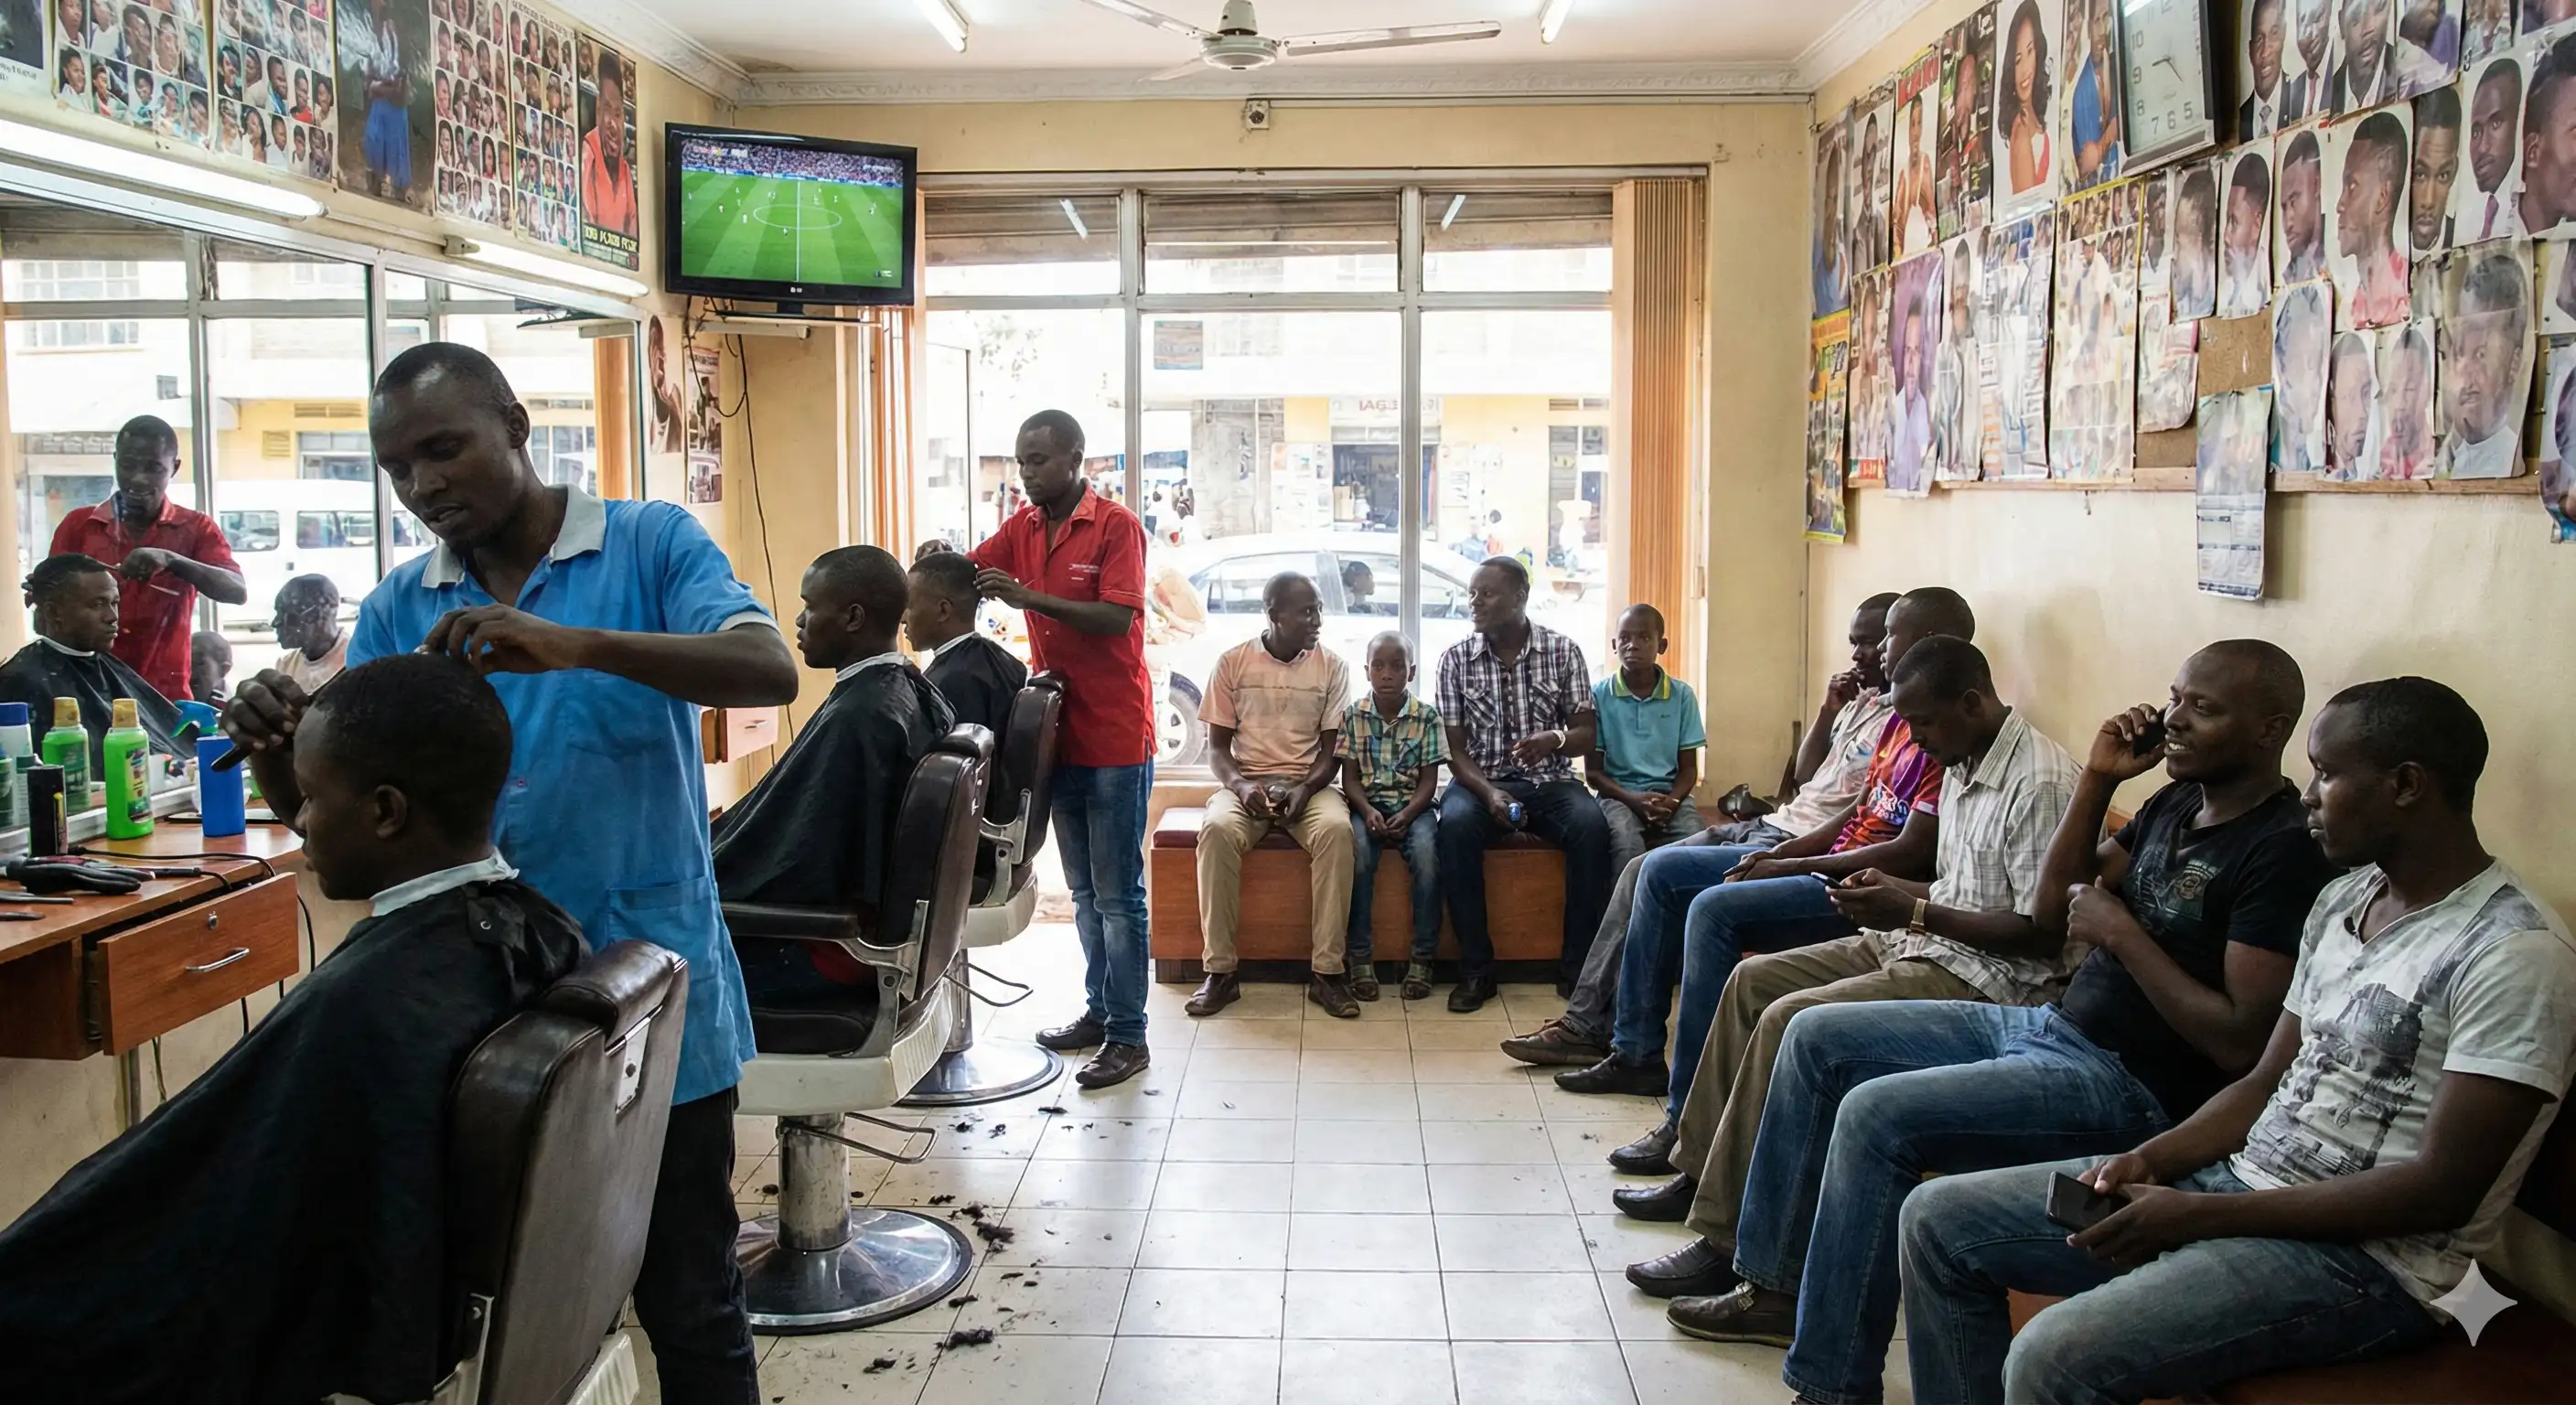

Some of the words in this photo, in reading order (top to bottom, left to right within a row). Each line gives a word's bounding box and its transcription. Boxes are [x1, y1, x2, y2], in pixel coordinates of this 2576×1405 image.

[2131, 29, 2143, 49] 10
[2132, 66, 2141, 84] 9
[2136, 99, 2145, 116] 8
[2184, 101, 2193, 121] 5
[2151, 115, 2159, 134] 7
[2167, 110, 2176, 130] 6
